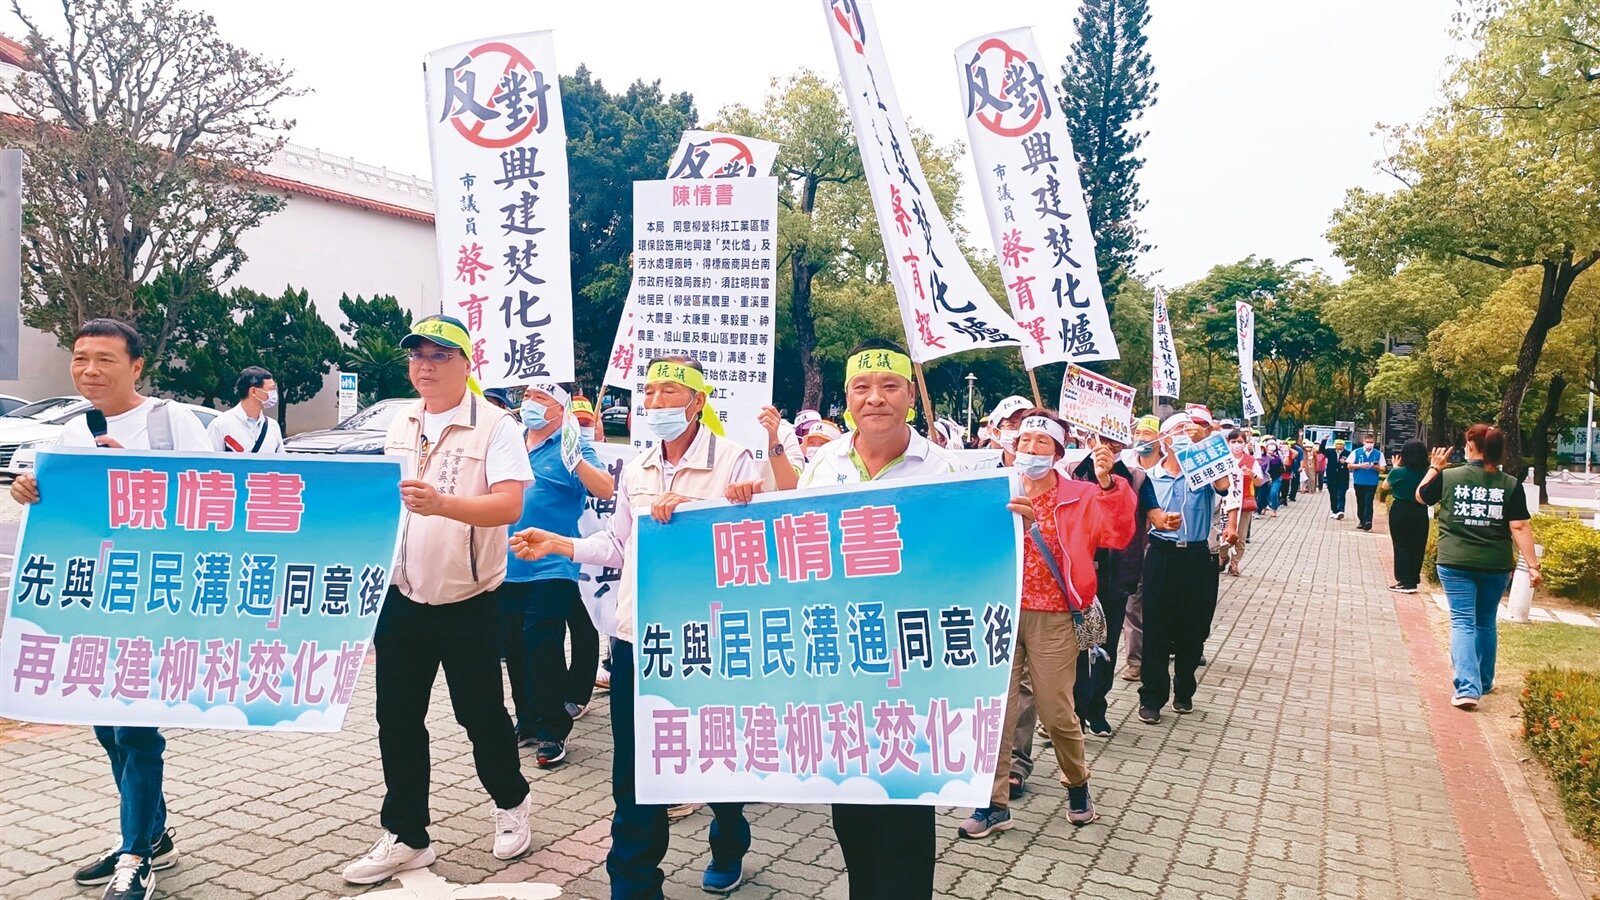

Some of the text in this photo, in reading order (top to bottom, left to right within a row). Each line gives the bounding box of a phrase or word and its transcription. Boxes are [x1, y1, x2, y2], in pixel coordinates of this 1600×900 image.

[439, 56, 552, 135] 反對
[968, 52, 1052, 120] 反對
[459, 172, 480, 237] 市議員
[672, 184, 734, 207] 陳情書
[993, 163, 1015, 223] 市議員
[494, 146, 551, 380] 興建焚化爐
[1020, 131, 1100, 358] 興建焚化爐
[657, 364, 687, 383] 抗議
[857, 354, 892, 370] 抗議
[108, 468, 305, 533] 陳情書
[1453, 484, 1505, 503] 林俊憲
[712, 504, 904, 588] 陳情書
[13, 632, 366, 706] 再興建柳科焚化爐
[651, 696, 1002, 777] 再興建柳科焚化爐
